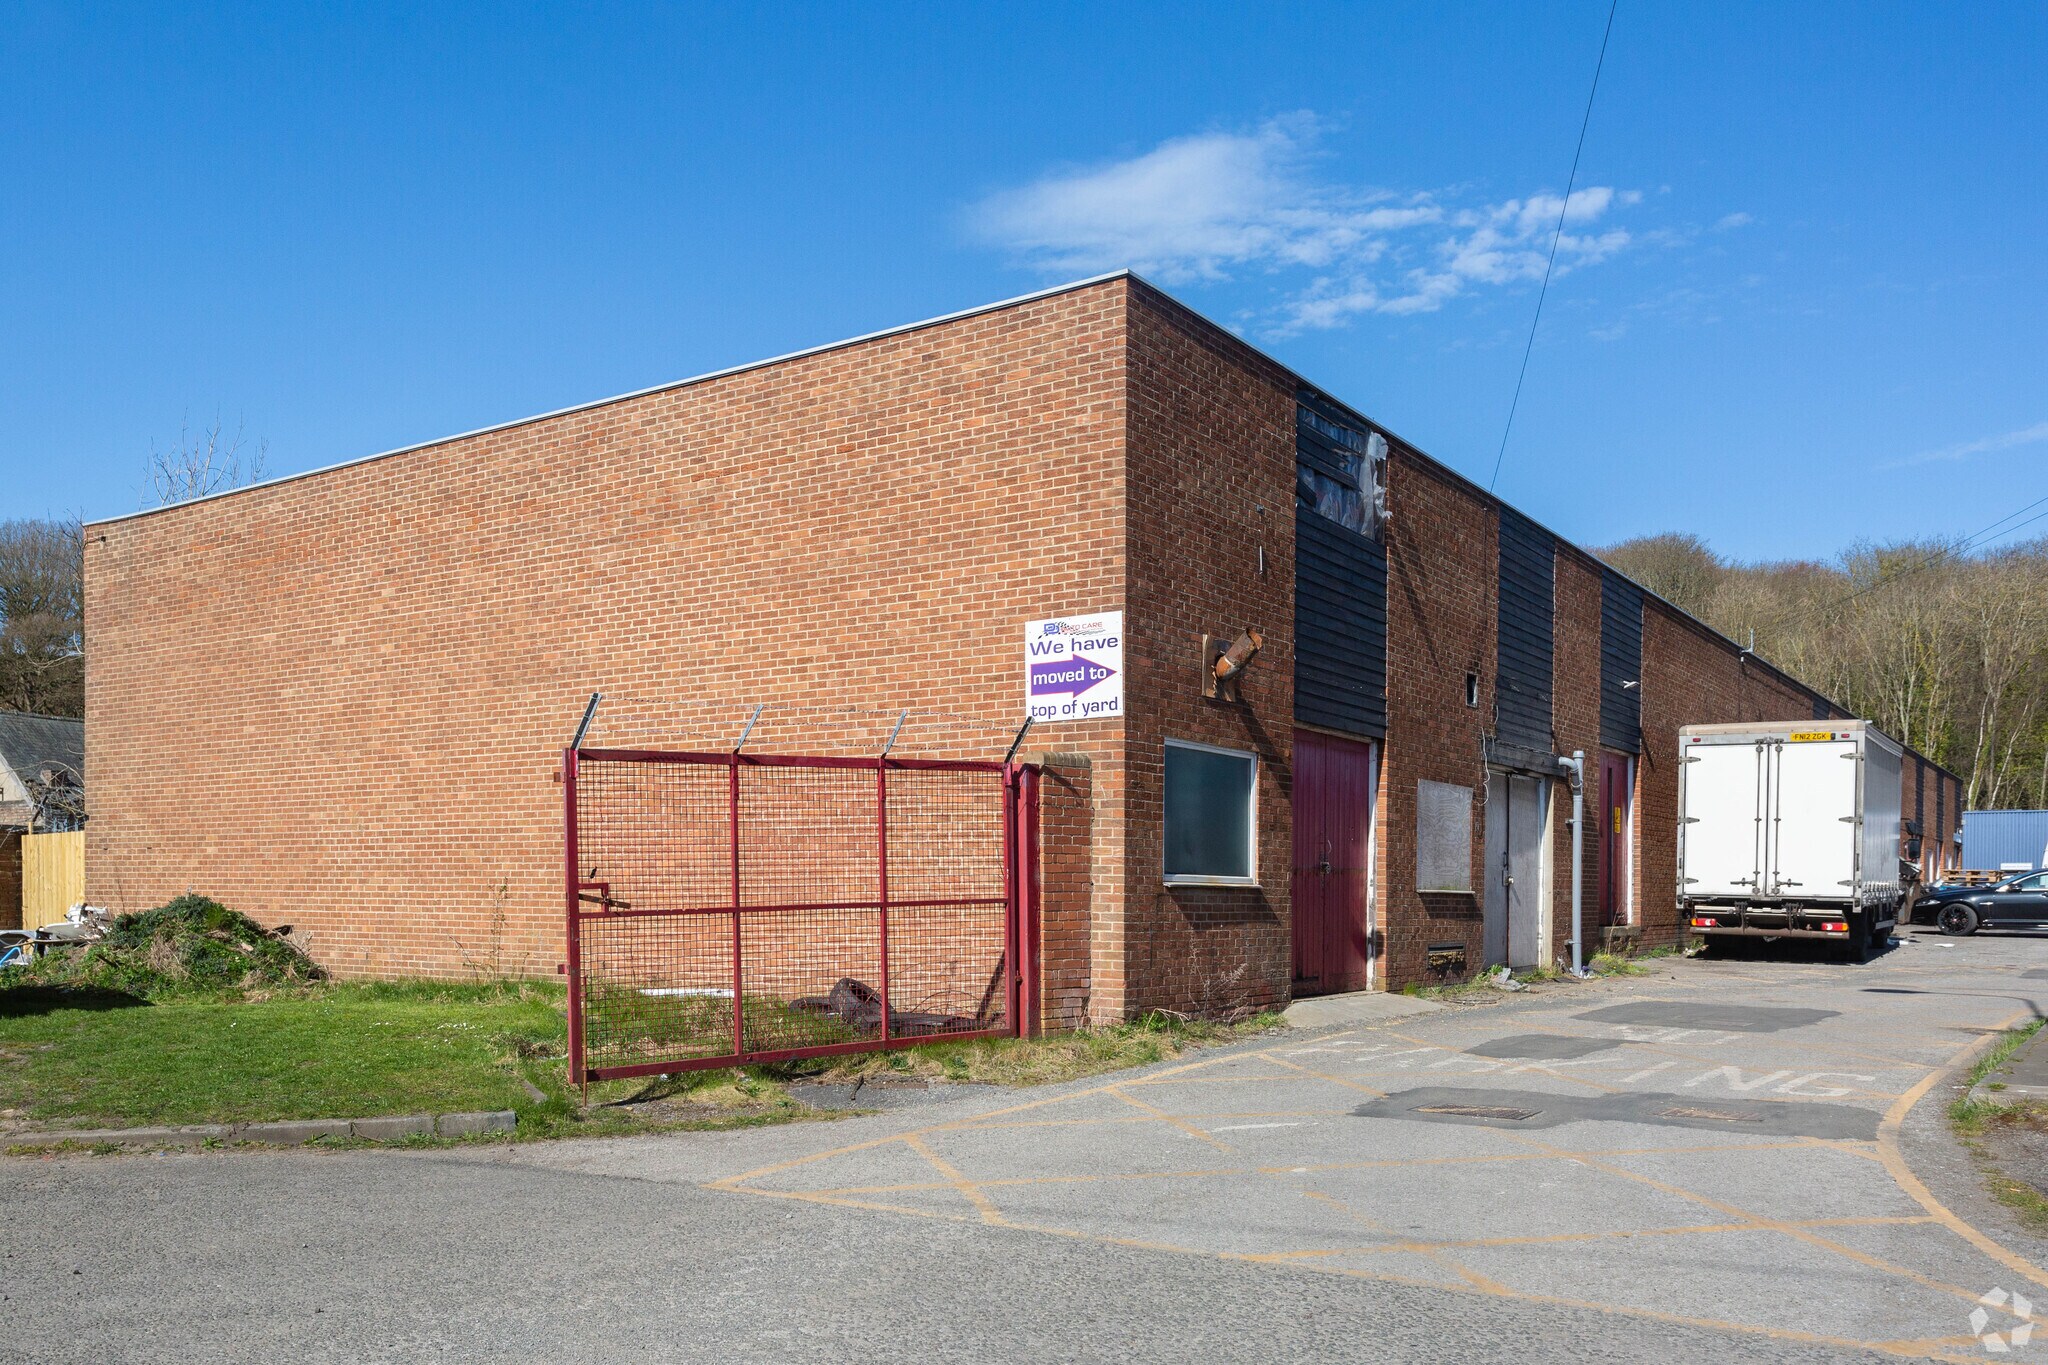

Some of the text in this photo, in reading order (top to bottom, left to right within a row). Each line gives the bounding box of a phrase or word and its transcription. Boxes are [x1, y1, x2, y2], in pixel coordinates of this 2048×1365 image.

[1082, 621, 1103, 629] CARE
[1029, 637, 1118, 656] We have
[1033, 666, 1107, 686] moved to
[1031, 696, 1118, 719] top of yard
[1285, 1040, 1876, 1097] PKING
